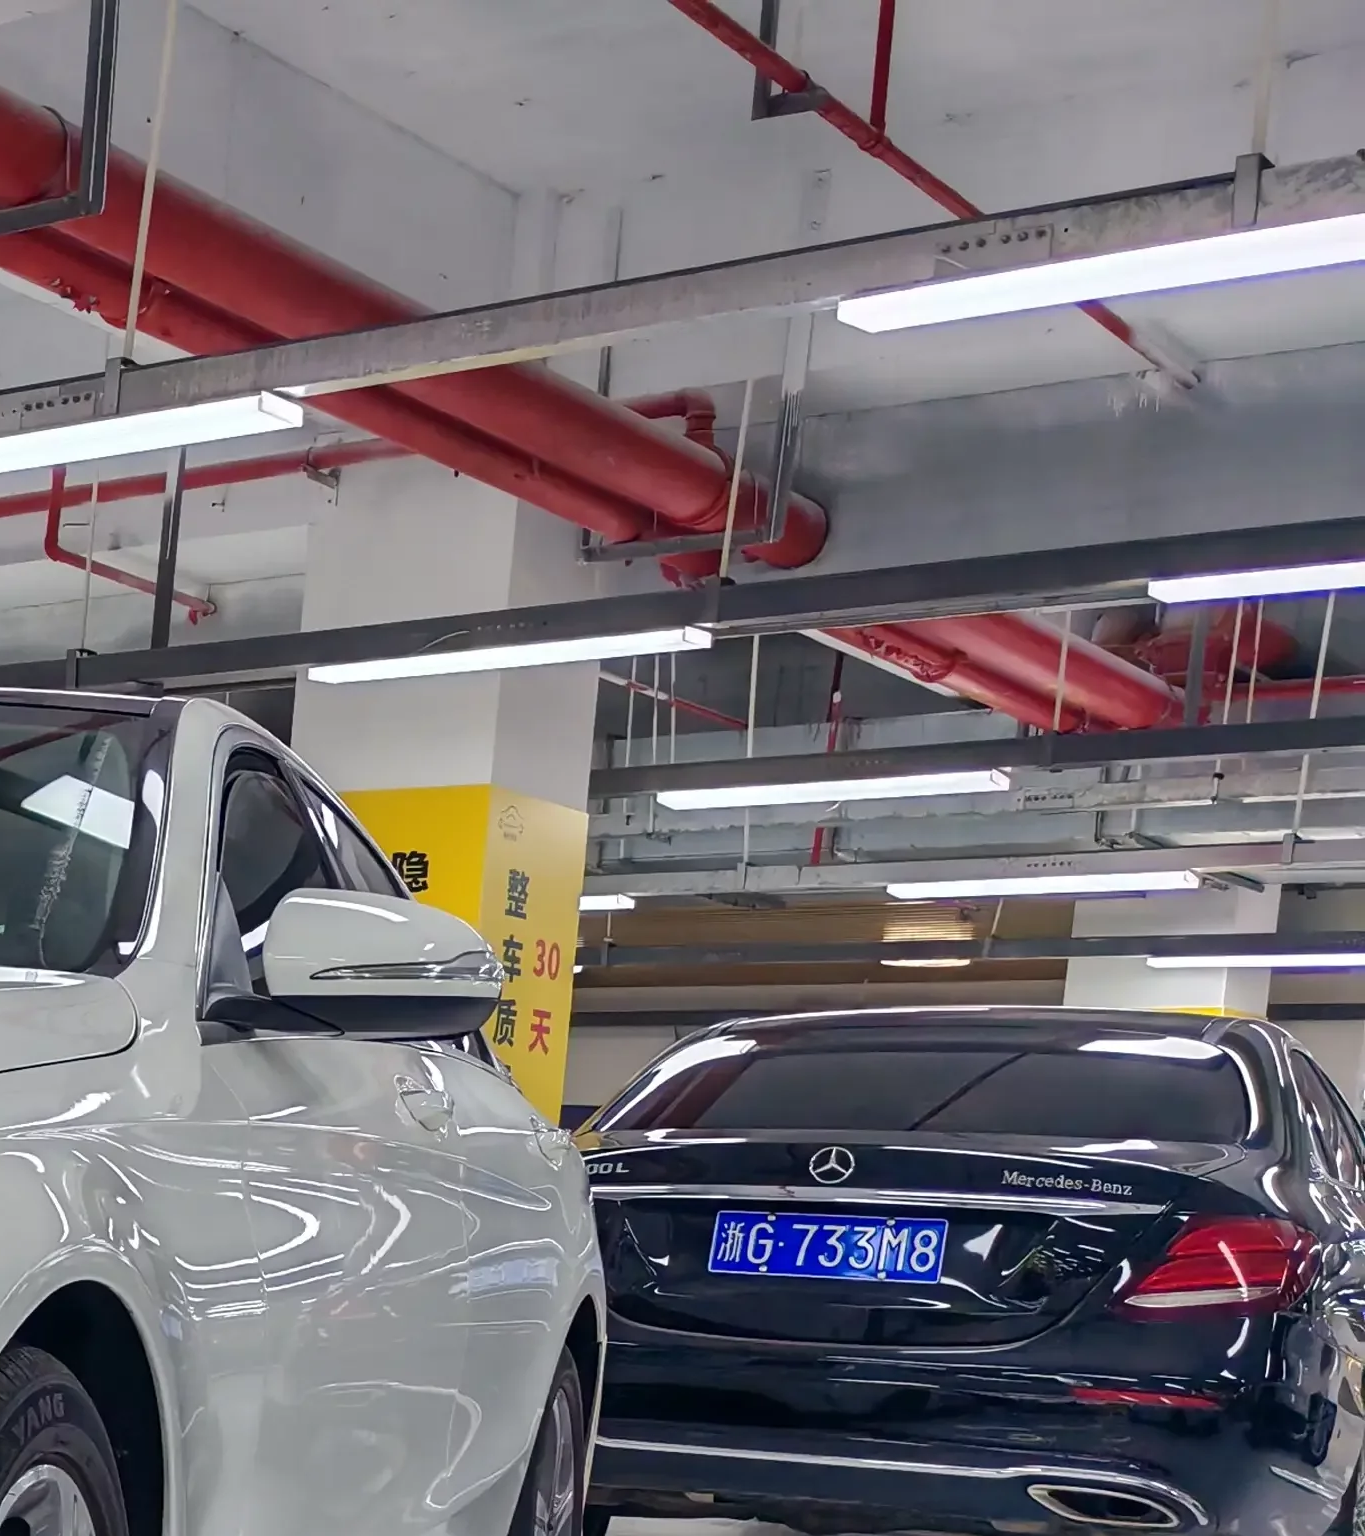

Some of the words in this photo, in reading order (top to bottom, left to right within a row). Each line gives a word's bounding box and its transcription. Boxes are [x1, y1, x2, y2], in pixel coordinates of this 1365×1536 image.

[492, 868, 530, 1076] 整车质
[1001, 1169, 1133, 1196] Mercedes-Benz
[12, 1392, 66, 1446] YANG
